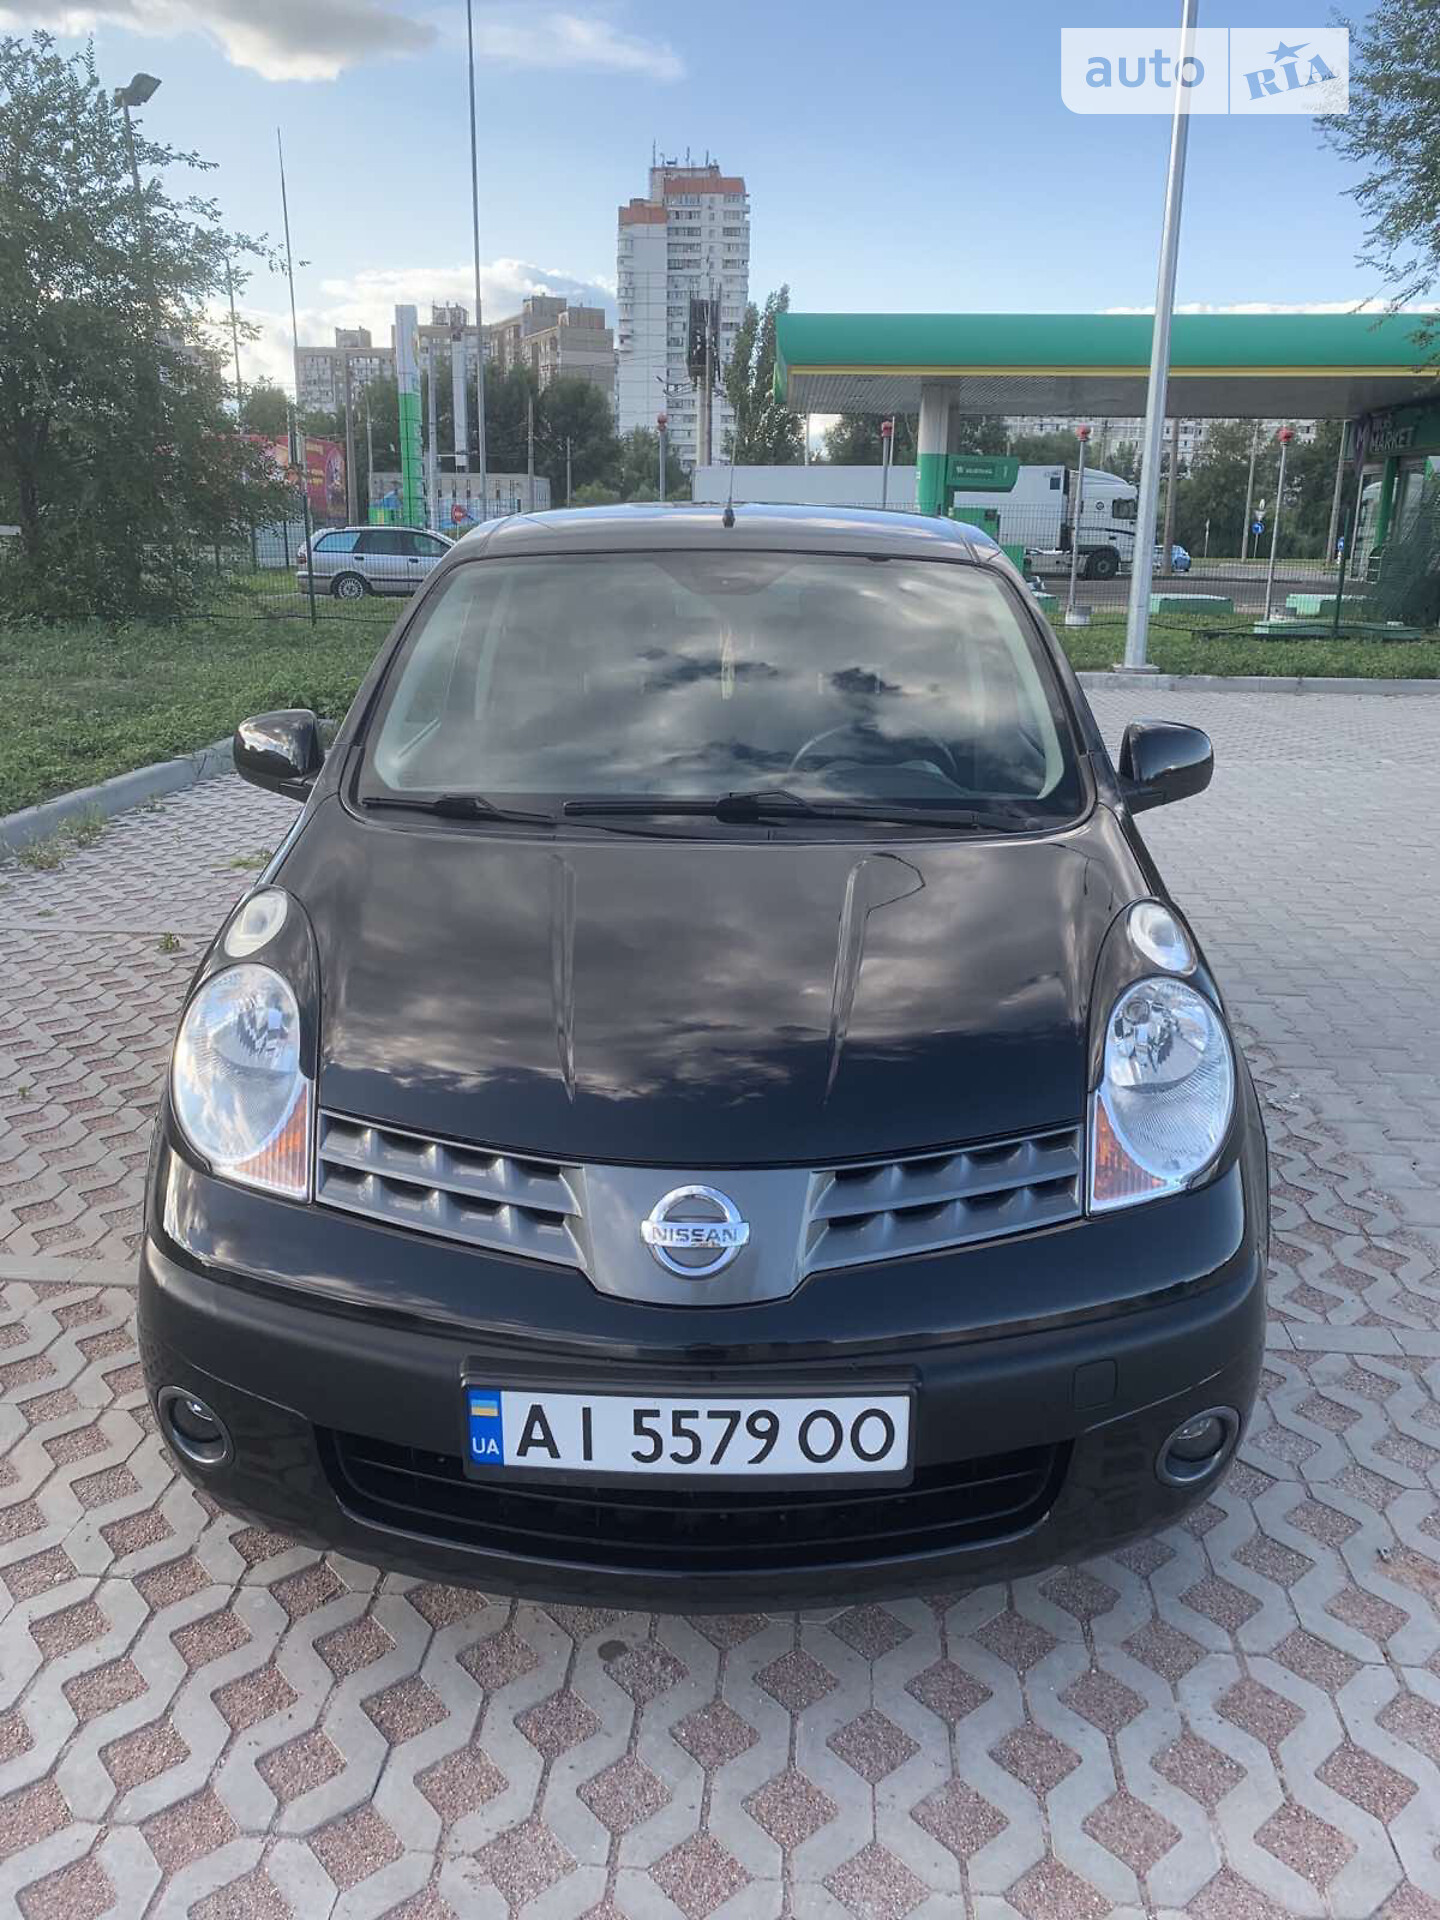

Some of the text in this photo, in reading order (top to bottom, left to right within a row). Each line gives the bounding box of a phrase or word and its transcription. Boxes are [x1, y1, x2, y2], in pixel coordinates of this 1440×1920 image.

[1369, 427, 1414, 453] MARKET
[652, 1226, 738, 1243] NISSAN
[472, 1437, 500, 1455] UA
[631, 1408, 780, 1465] 5579
